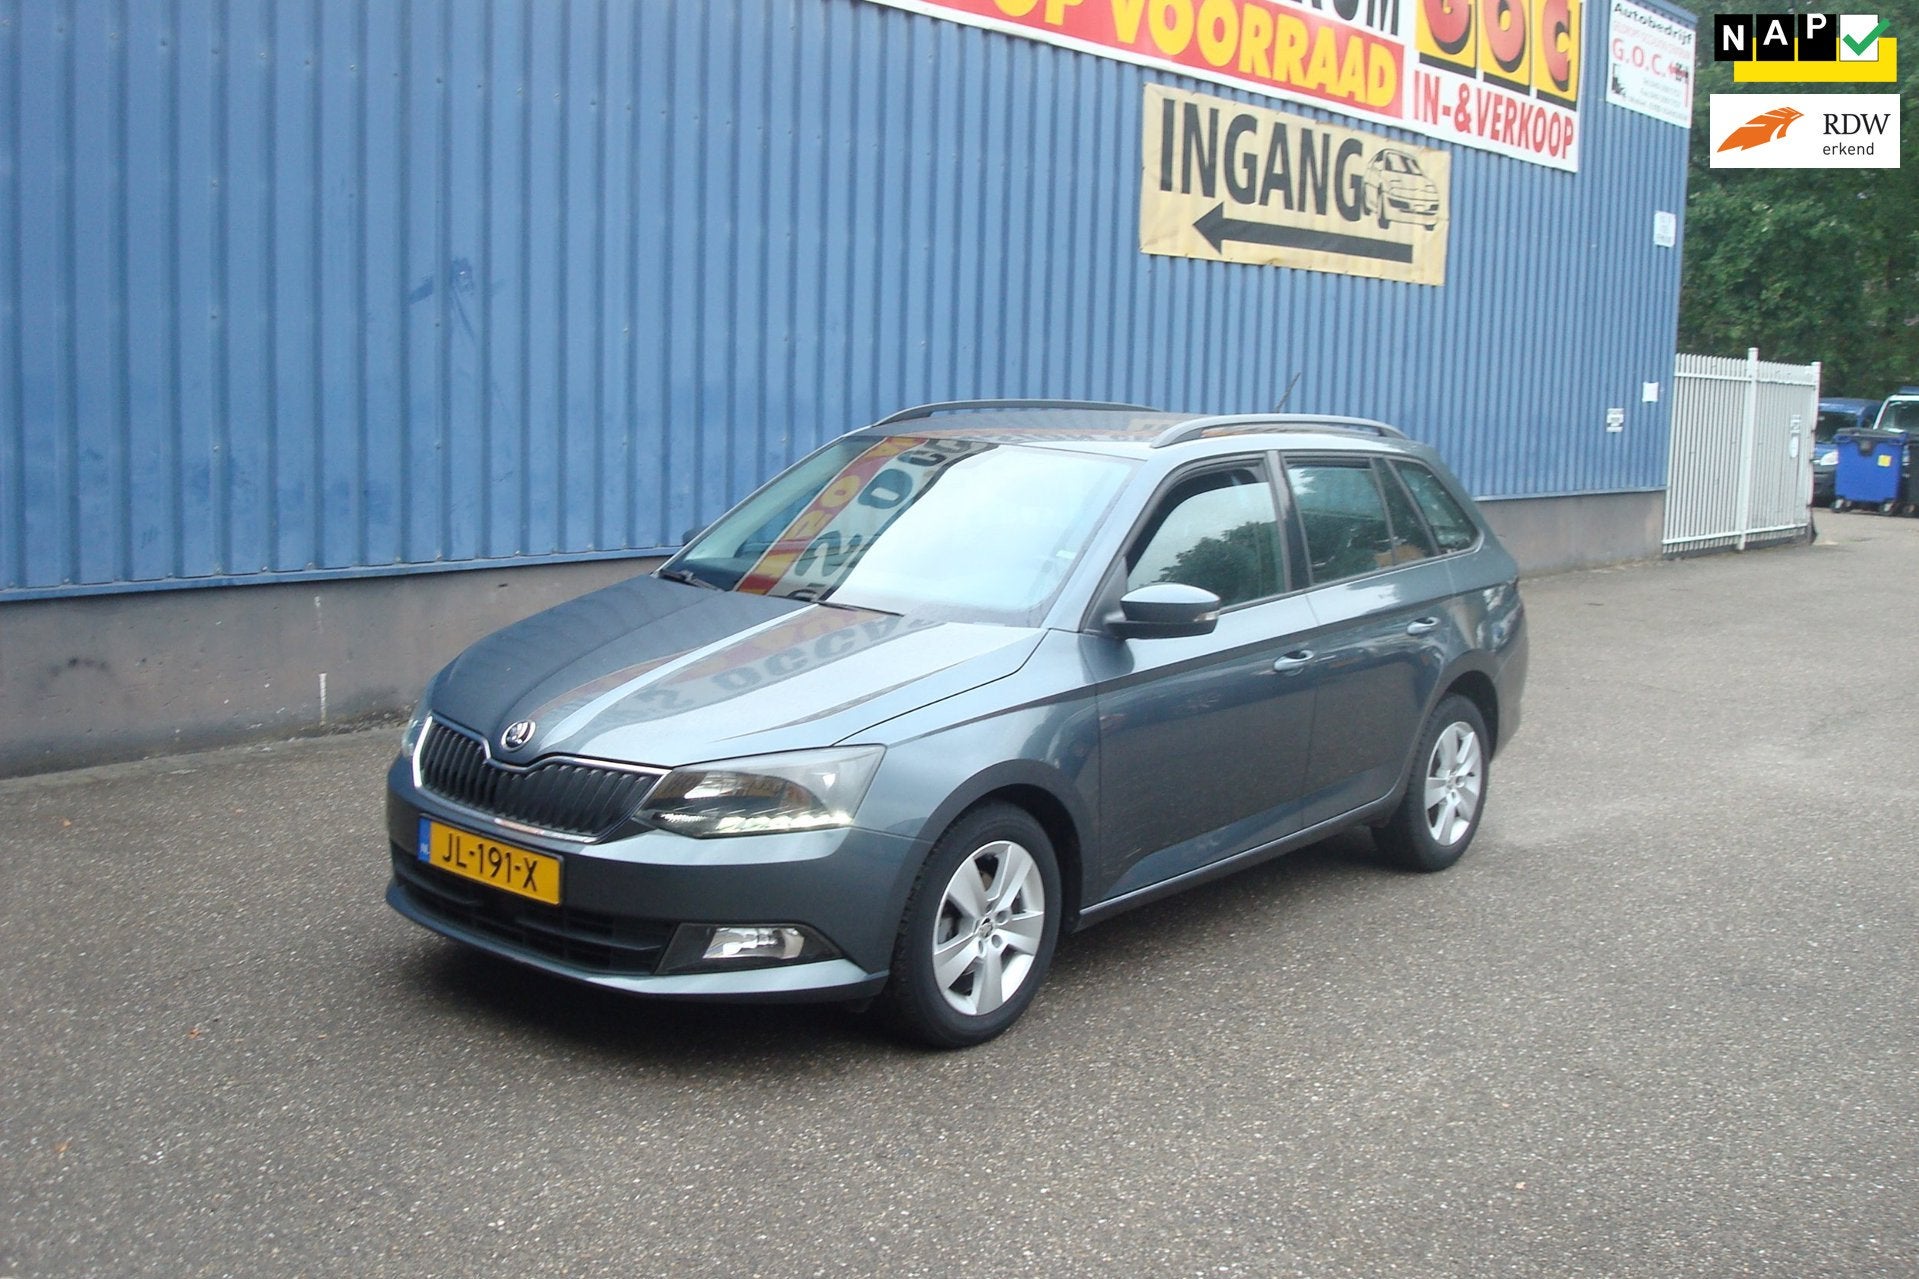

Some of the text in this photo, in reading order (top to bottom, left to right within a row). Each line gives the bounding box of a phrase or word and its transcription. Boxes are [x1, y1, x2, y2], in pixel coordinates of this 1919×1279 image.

[1110, 0, 1397, 107] VOORRAAD
[1614, 3, 1692, 45] Autobedrijf
[1160, 98, 1363, 222] INGANG
[442, 833, 538, 892] JL-191-X
